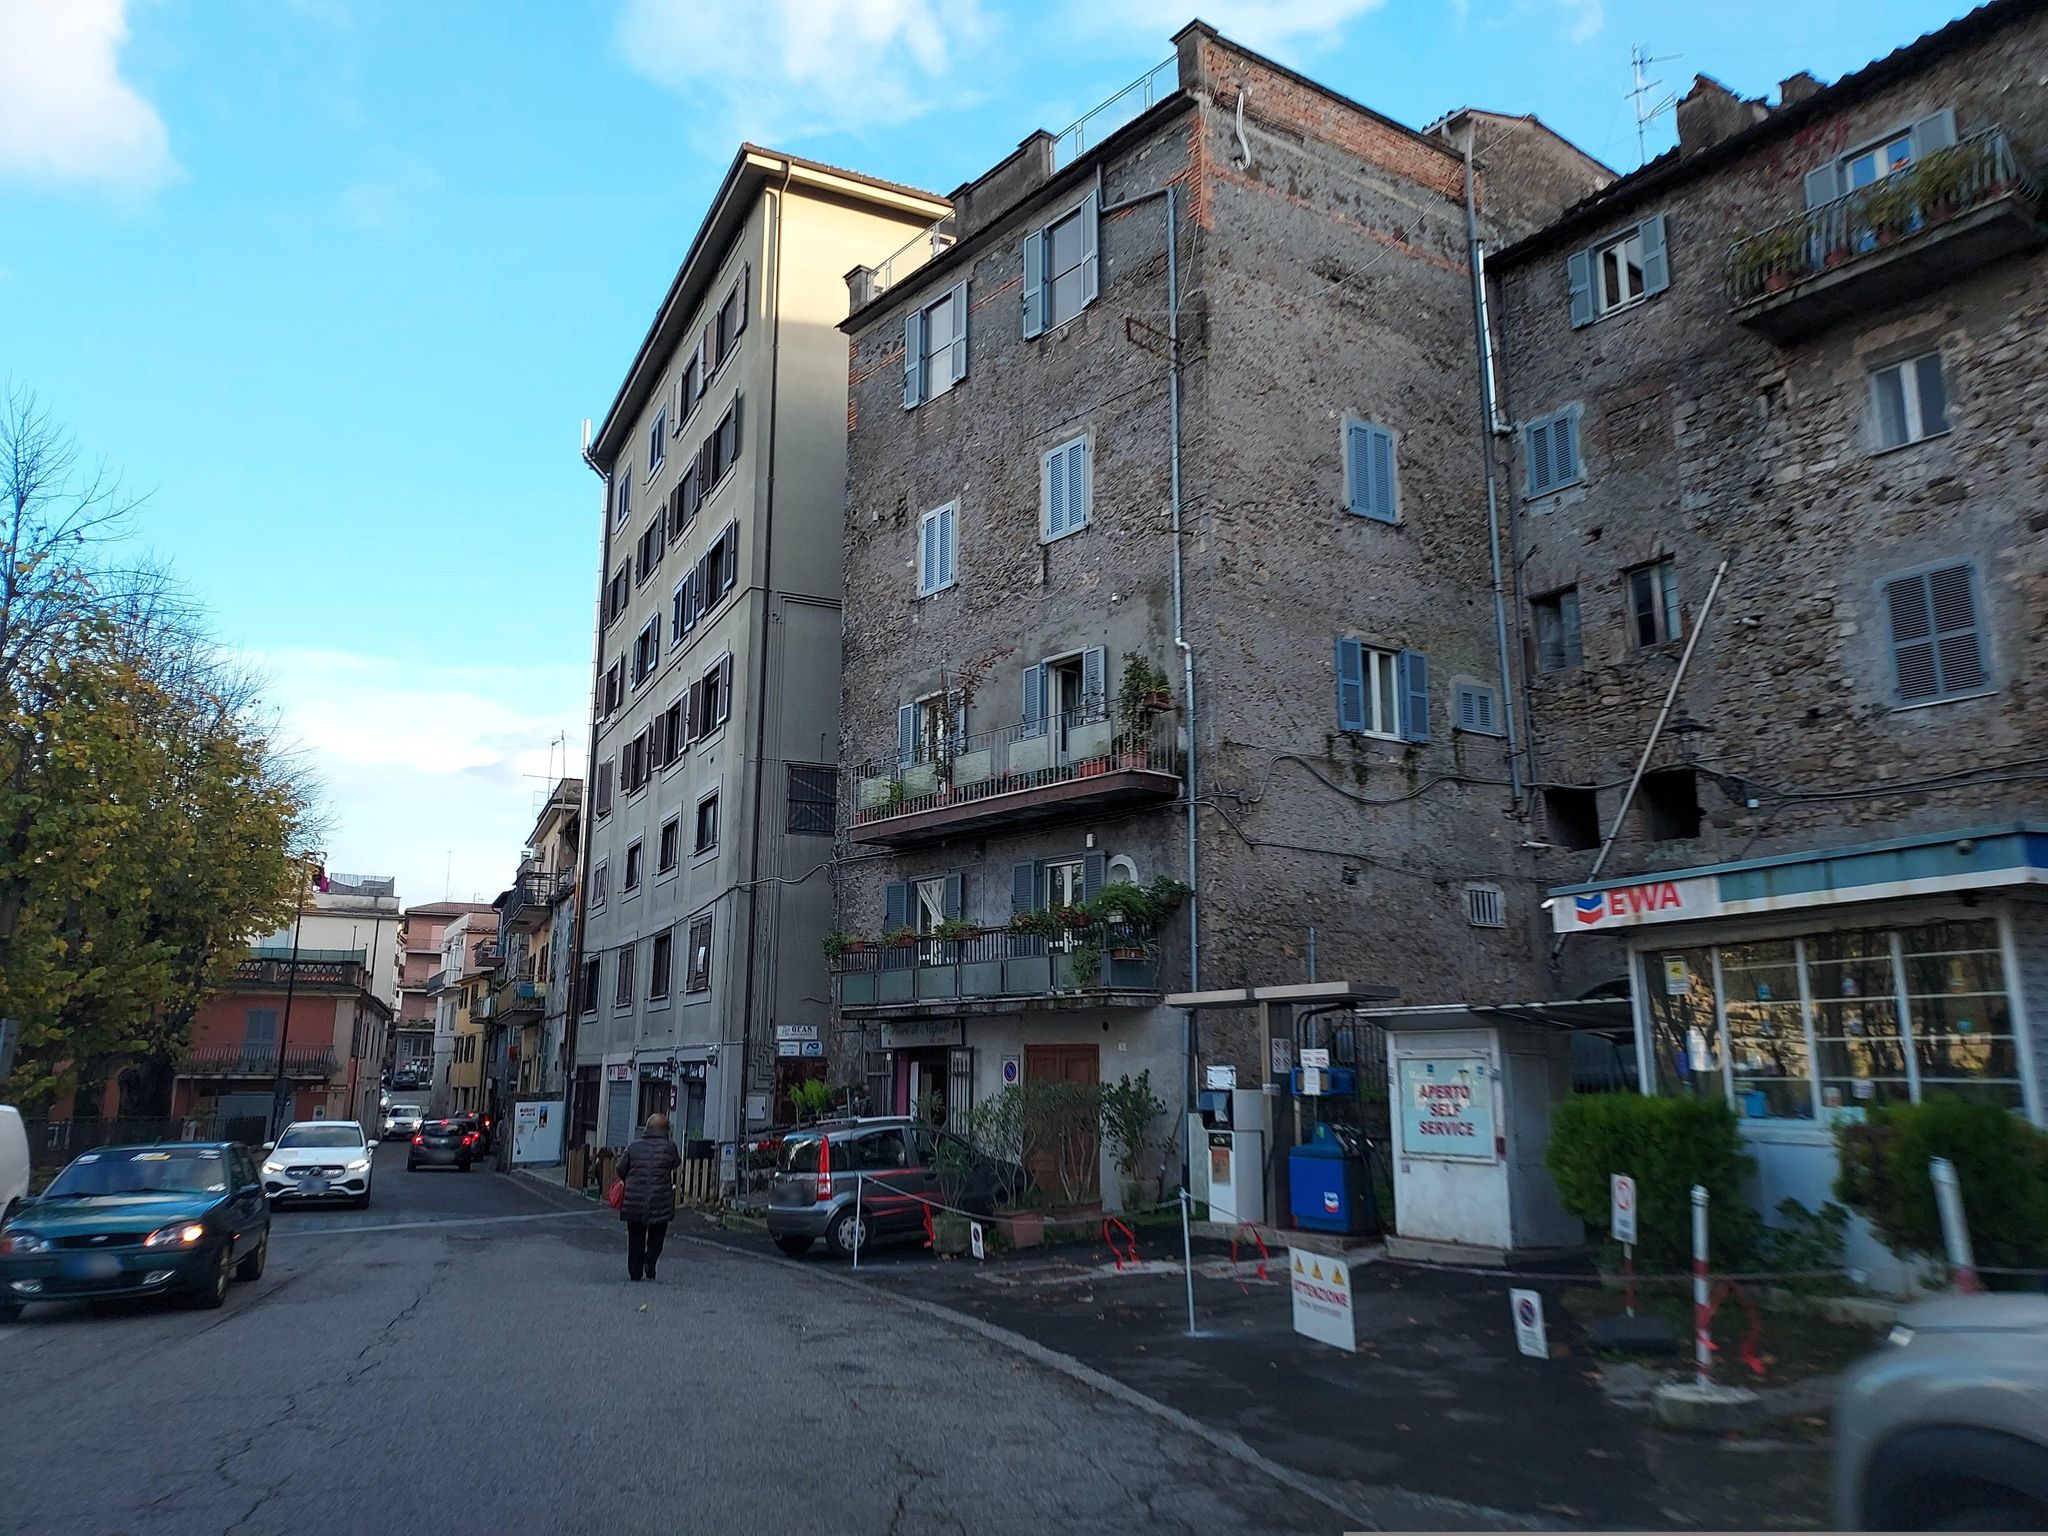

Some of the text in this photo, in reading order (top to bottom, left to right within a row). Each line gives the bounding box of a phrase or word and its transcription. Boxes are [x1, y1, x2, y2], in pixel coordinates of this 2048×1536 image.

[1608, 881, 1682, 915] EWA
[1419, 1085, 1470, 1098] APERTO
[1429, 1103, 1462, 1117] SELF
[1419, 1121, 1476, 1137] SERVICE
